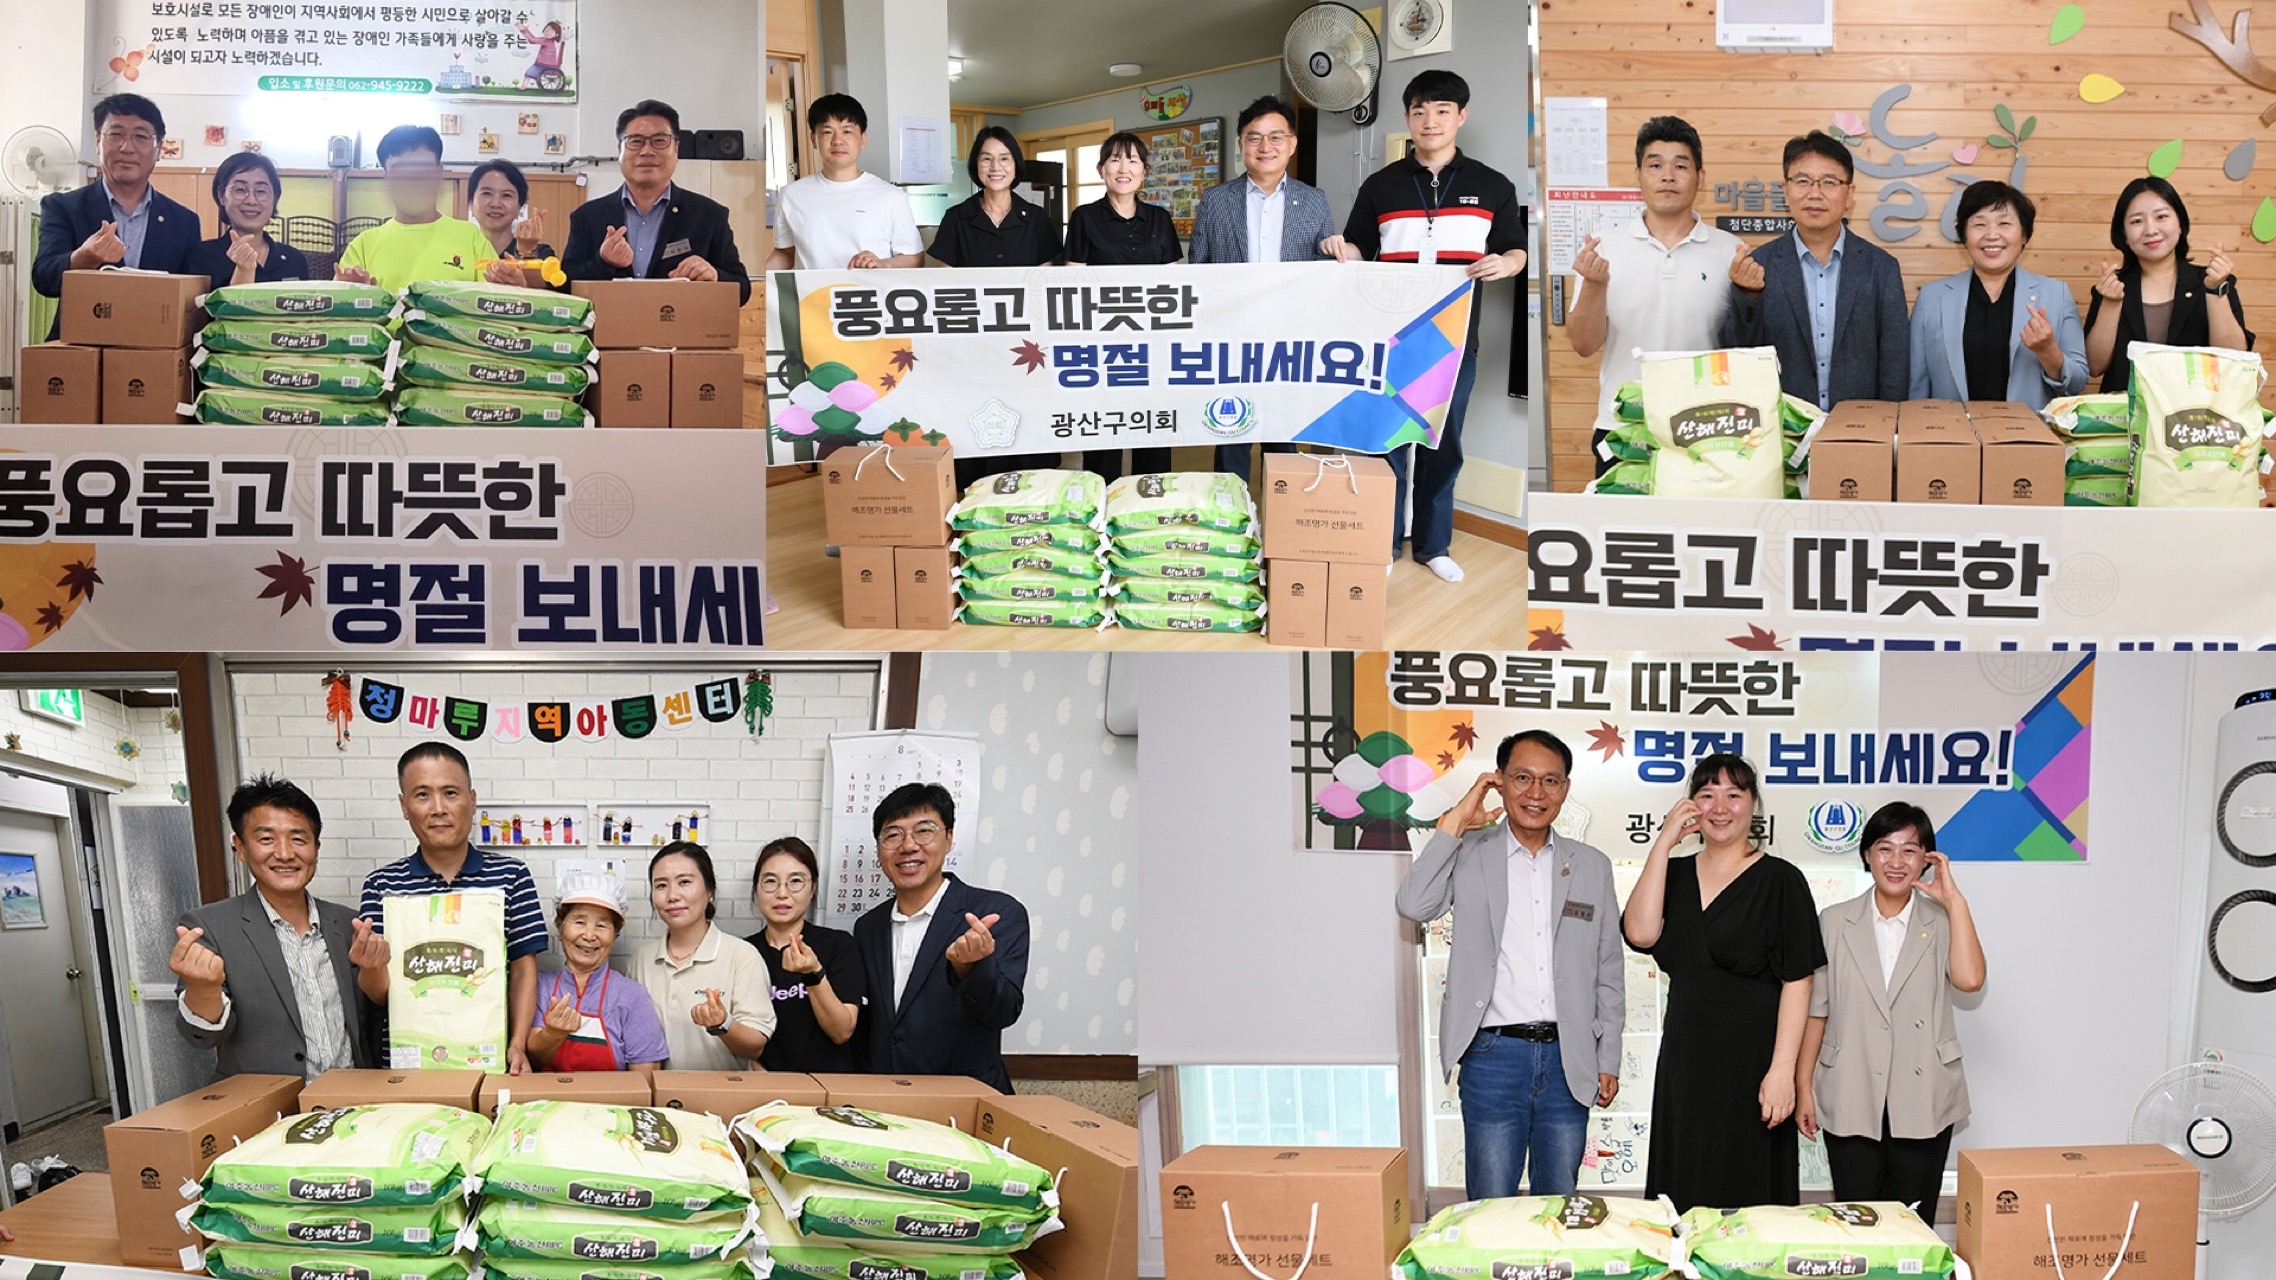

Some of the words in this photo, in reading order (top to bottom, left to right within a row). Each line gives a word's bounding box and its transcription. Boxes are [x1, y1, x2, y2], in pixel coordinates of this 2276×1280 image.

[151, 2, 214, 17] 보호시설로
[218, 4, 242, 18] 모든
[246, 4, 296, 19] 장애인이
[300, 5, 376, 20] 지역사회에서
[380, 6, 417, 22] 평등한
[421, 7, 470, 22] 시민으로
[475, 8, 512, 24] 살아갈
[516, 10, 529, 24] 수
[151, 27, 188, 42] 있도록
[197, 27, 246, 43] 노력하며
[250, 29, 289, 44] 아픔을
[294, 30, 318, 44] 겪고
[323, 31, 348, 46] 있는
[352, 31, 390, 46] 장애인
[395, 32, 457, 48] 가족들에게
[461, 33, 499, 49] 사랑을
[503, 34, 528, 49] 주는
[148, 50, 185, 64] 시설이
[190, 51, 227, 65] 되고자
[231, 51, 322, 66] 노력하겠습니다.
[268, 77, 290, 90] 입소
[302, 78, 346, 91] 후원문의
[348, 79, 425, 91] 062-945-9222
[833, 287, 1031, 338] 풍요롭고
[1046, 284, 1199, 331] 따뜻한
[1052, 343, 1151, 389] 명절
[1167, 340, 1387, 391] 보내세요!
[1051, 409, 1177, 437] 광산구의회
[1677, 415, 1753, 440] 산해진미
[2171, 423, 2240, 444] 산해진미
[0, 461, 295, 538] 풍요롭고
[321, 462, 567, 540] 따뜻한
[1528, 529, 1764, 611] 요롭고
[1793, 537, 2050, 619] 따뜻한
[327, 564, 487, 645] 명절
[519, 564, 766, 647] 보내세
[1390, 651, 1611, 710] 풍요롭고
[1630, 659, 1801, 716] 따뜻한
[898, 745, 904, 754] 8
[1765, 730, 2012, 786] 보내세요!
[845, 845, 849, 853] 1
[858, 845, 864, 854] 2
[842, 860, 848, 869] 8
[857, 859, 863, 869] 9
[840, 875, 848, 883] 15
[855, 875, 864, 883] 16
[870, 874, 881, 883] 17
[838, 889, 847, 897] 22
[852, 889, 863, 897] 23
[869, 889, 880, 897] 24
[837, 903, 846, 912] 29
[851, 903, 862, 912] 30
[409, 955, 478, 974] 산해진미
[897, 1167, 960, 1189] 산해진미
[300, 1183, 360, 1199] 산해진미
[578, 1189, 641, 1207] 산해진미
[300, 1225, 360, 1241] 산해진미
[906, 1219, 968, 1238] 산해진미
[584, 1243, 645, 1259] 산해진미
[1796, 1260, 1856, 1276] 산해진미
